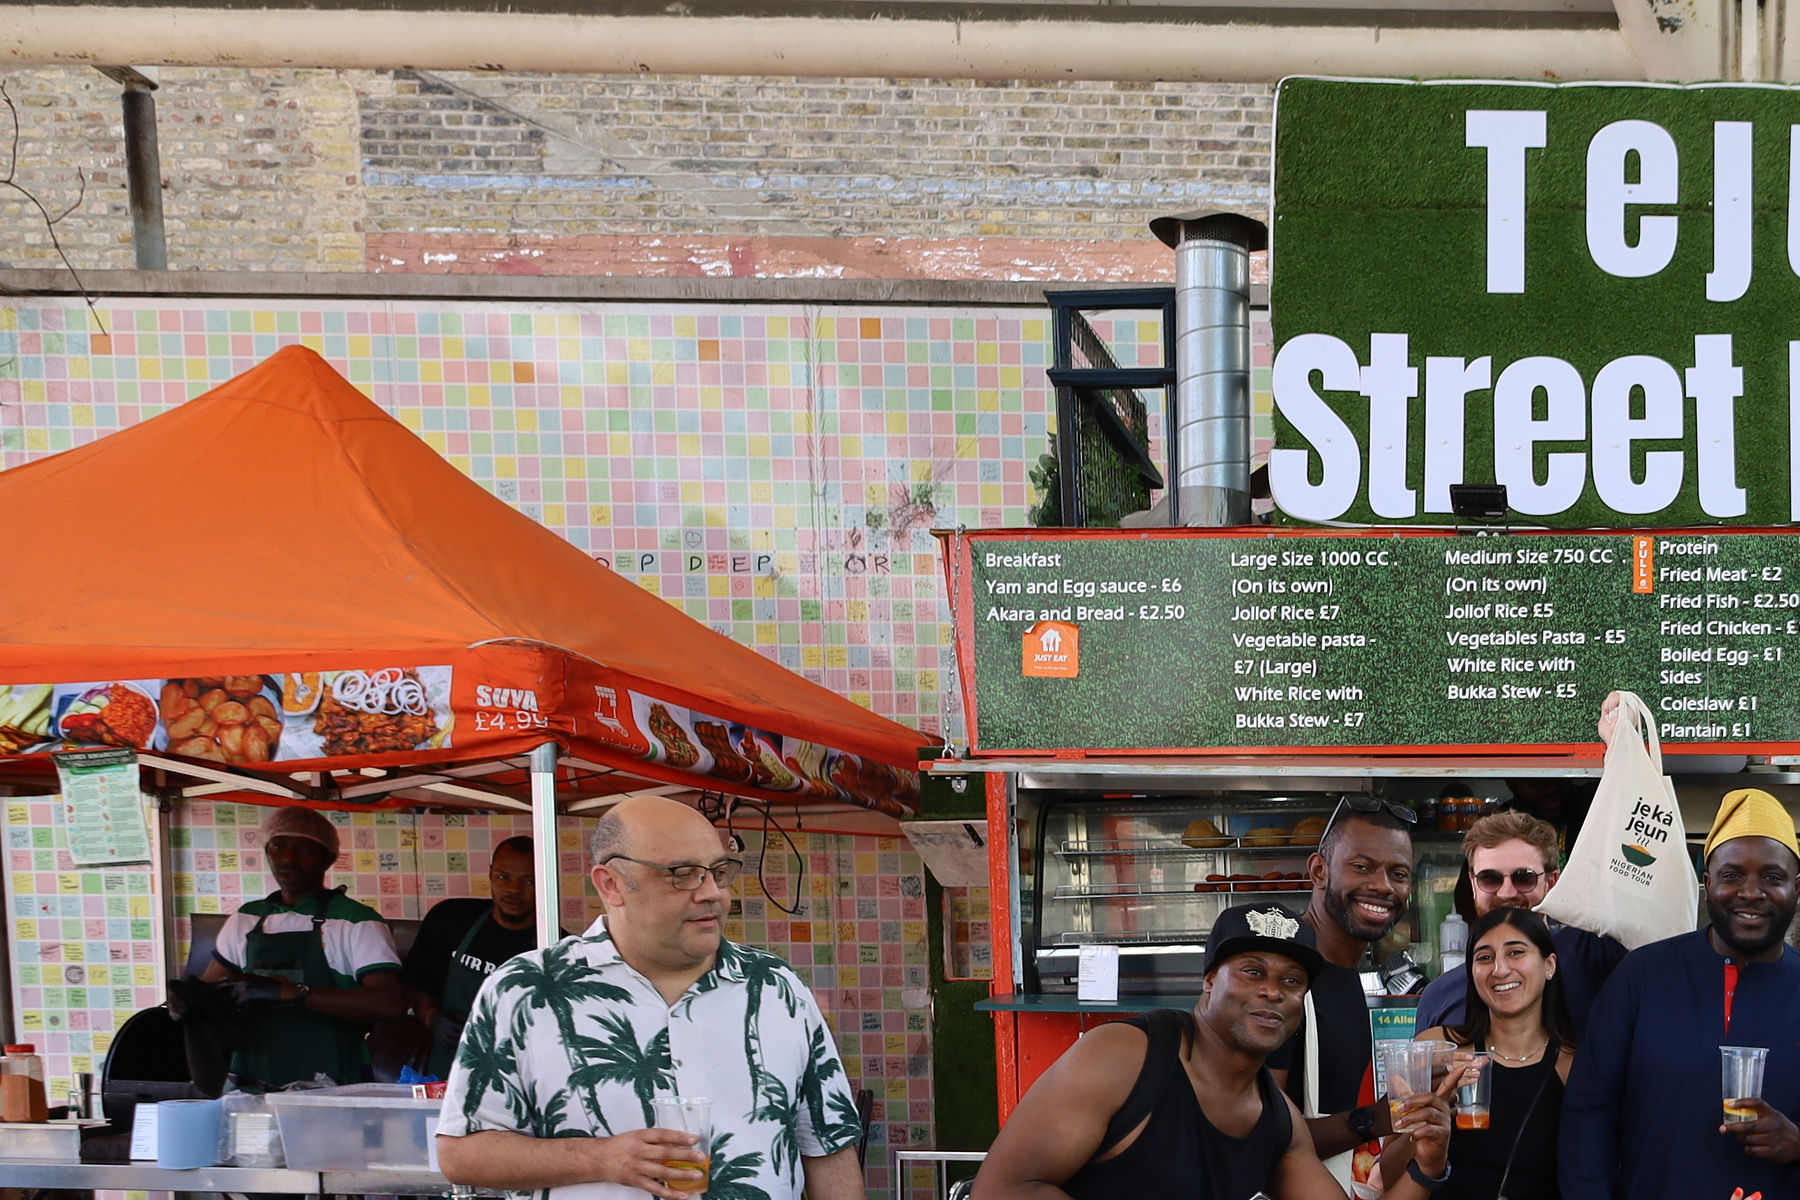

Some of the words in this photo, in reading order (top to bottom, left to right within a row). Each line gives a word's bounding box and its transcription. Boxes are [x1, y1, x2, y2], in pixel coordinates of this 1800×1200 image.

[1267, 332, 1747, 520] Street
[1444, 549, 1511, 565] Medium
[1516, 548, 1548, 564] Size
[1552, 548, 1584, 563] 750
[1588, 548, 1613, 563] CC
[1660, 541, 1718, 555] Protein
[985, 551, 1061, 567] Breakfast
[1230, 551, 1277, 570] Large
[1281, 550, 1313, 566] Size
[1320, 550, 1360, 566] 1000
[1364, 550, 1388, 566] CC
[1638, 540, 1648, 577] PULL
[1659, 566, 1701, 582] Fried
[1705, 566, 1748, 581] Meat
[1761, 566, 1782, 581] £2
[985, 579, 1021, 594] Yam
[1025, 578, 1057, 594] and
[1062, 578, 1095, 597] Egg
[1099, 581, 1147, 593] sauce
[1161, 577, 1182, 592] £6
[1231, 578, 1262, 598] (On
[1267, 578, 1285, 593] its
[1290, 577, 1332, 596] own)
[1659, 593, 1702, 608] Fried
[1706, 593, 1739, 609] Fish
[1753, 592, 1800, 608] £2.50
[985, 606, 1034, 621] Akara
[1038, 605, 1071, 621] and
[1076, 605, 1124, 620] Bread
[1138, 604, 1184, 620] £2.50
[1230, 604, 1277, 621] Jollof
[1280, 604, 1314, 620] Rice
[1319, 604, 1339, 620] £7
[1444, 603, 1491, 619] Jollof
[1494, 603, 1528, 618] Rice
[1532, 602, 1553, 617] £5
[1660, 620, 1702, 635] Fried
[1705, 620, 1771, 635] Chicken
[1231, 631, 1317, 651] Vegetable
[1321, 633, 1365, 650] pasta
[1445, 629, 1537, 650] Vegetables
[1542, 629, 1585, 644] Pasta
[1604, 628, 1625, 644] £5
[1034, 654, 1052, 662] JUST
[1053, 654, 1067, 662] EAT
[1660, 647, 1712, 662] Boiled
[1716, 646, 1748, 666] Egg
[1762, 646, 1781, 661] £1
[1233, 659, 1254, 675] £7
[1259, 658, 1316, 678] (Large)
[1659, 669, 1702, 684] Sides
[476, 684, 539, 712] SUYA
[1233, 685, 1283, 701] White
[1288, 685, 1321, 701] Rice
[1324, 684, 1362, 700] with
[1447, 684, 1496, 699] Bukka
[1500, 683, 1542, 699] Stew
[1555, 682, 1576, 698] £5
[1660, 695, 1734, 711] Coleslaw
[1737, 695, 1757, 710] £1
[1235, 712, 1284, 728] Bukka
[1288, 712, 1330, 727] Stew
[1343, 711, 1364, 727] £7
[1660, 722, 1727, 738] Plantain
[1731, 722, 1750, 737] £1
[1609, 866, 1629, 877] FOOD
[1632, 875, 1650, 886] TOUR
[1611, 859, 1653, 880] NIGERIAN
[1378, 1016, 1391, 1024] 14
